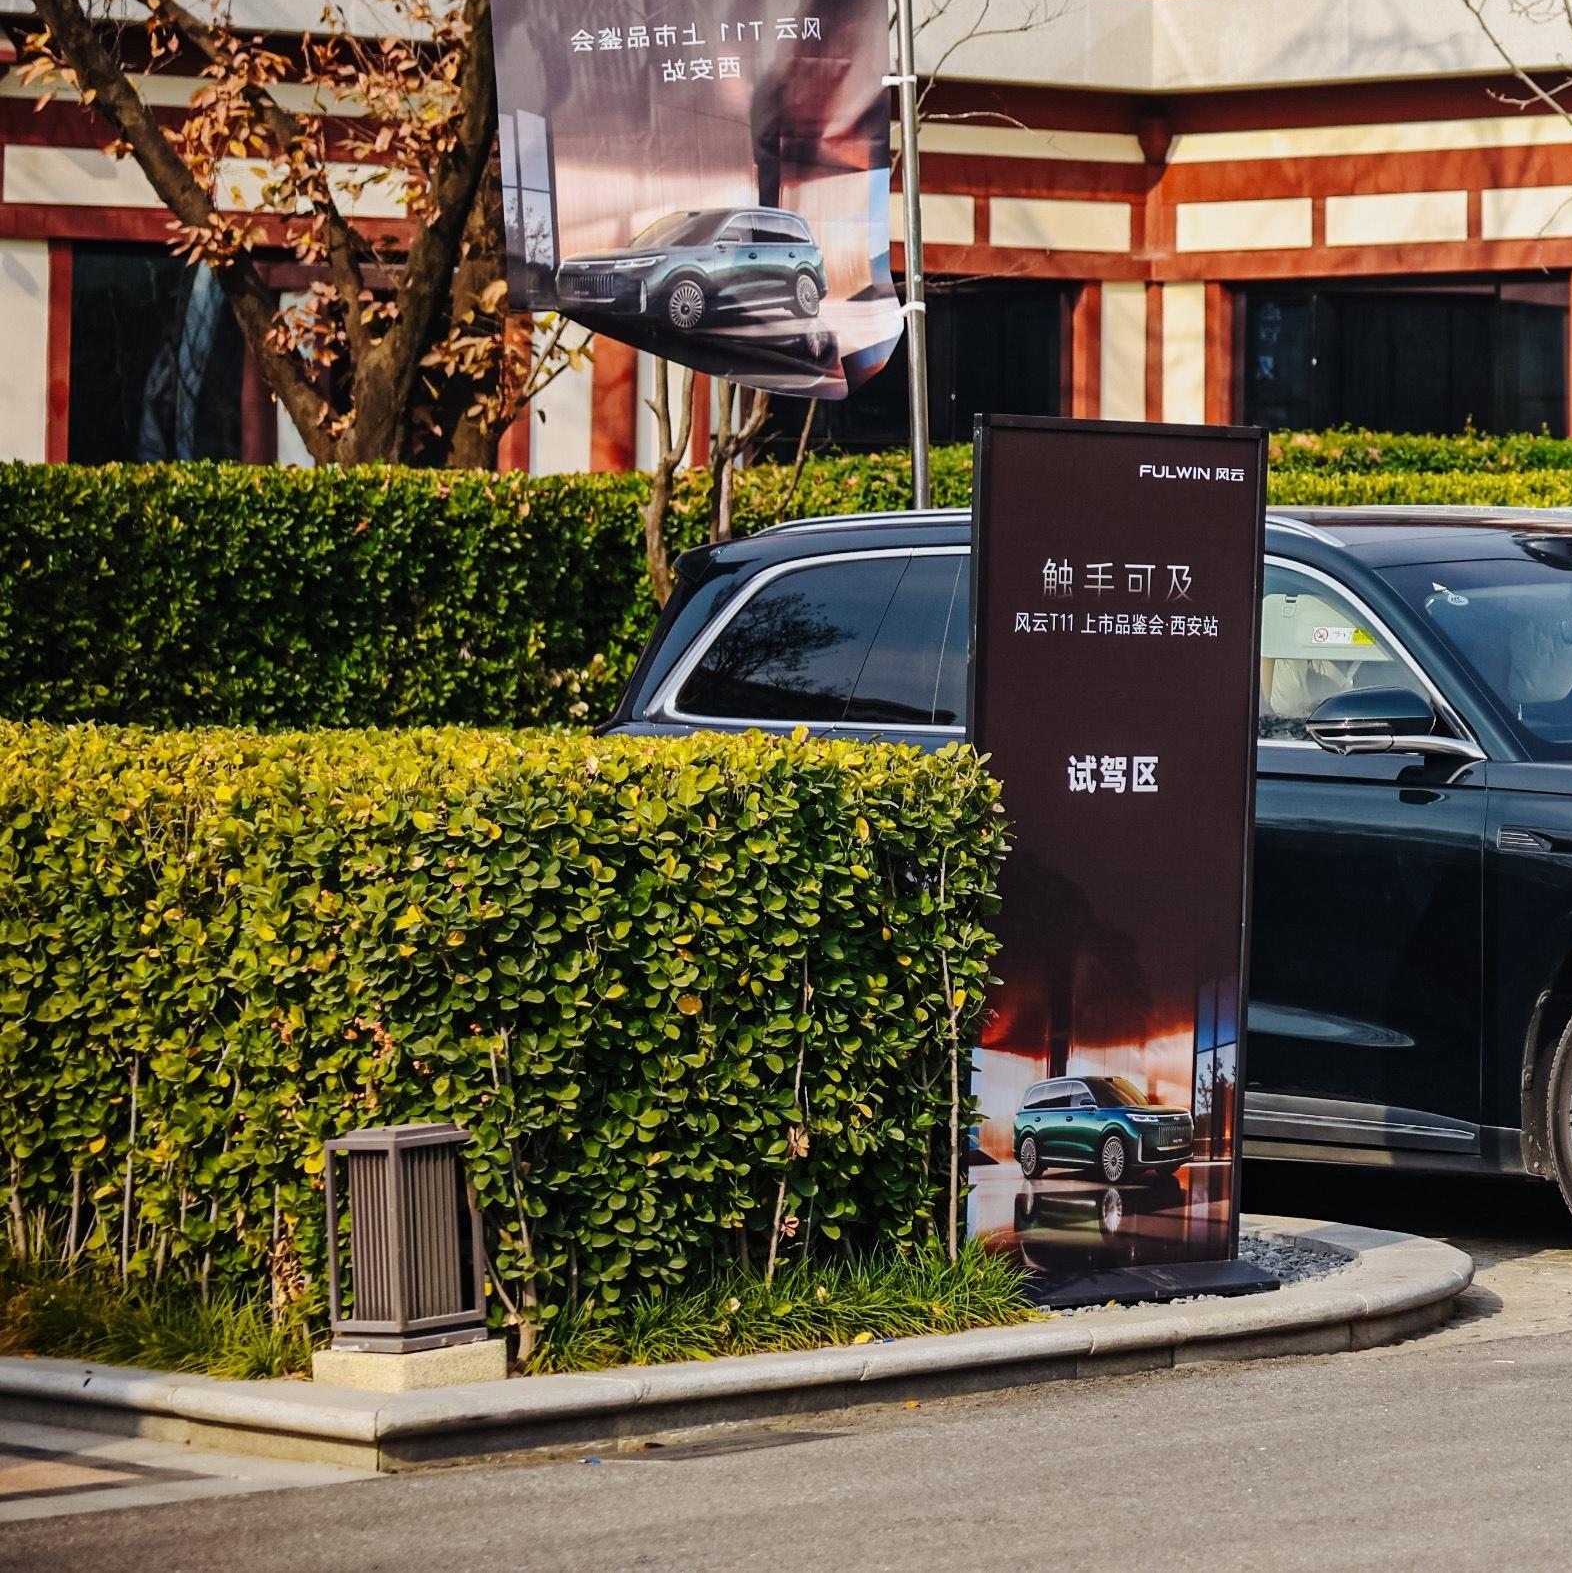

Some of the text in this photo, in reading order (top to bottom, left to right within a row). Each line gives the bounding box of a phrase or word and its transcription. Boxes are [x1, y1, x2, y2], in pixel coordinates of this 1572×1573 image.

[1139, 464, 1245, 482] FULWIN 风云
[1041, 557, 1194, 603] 触手可及
[1014, 611, 1074, 634] 风云T11
[1067, 754, 1160, 794] 试驾区
